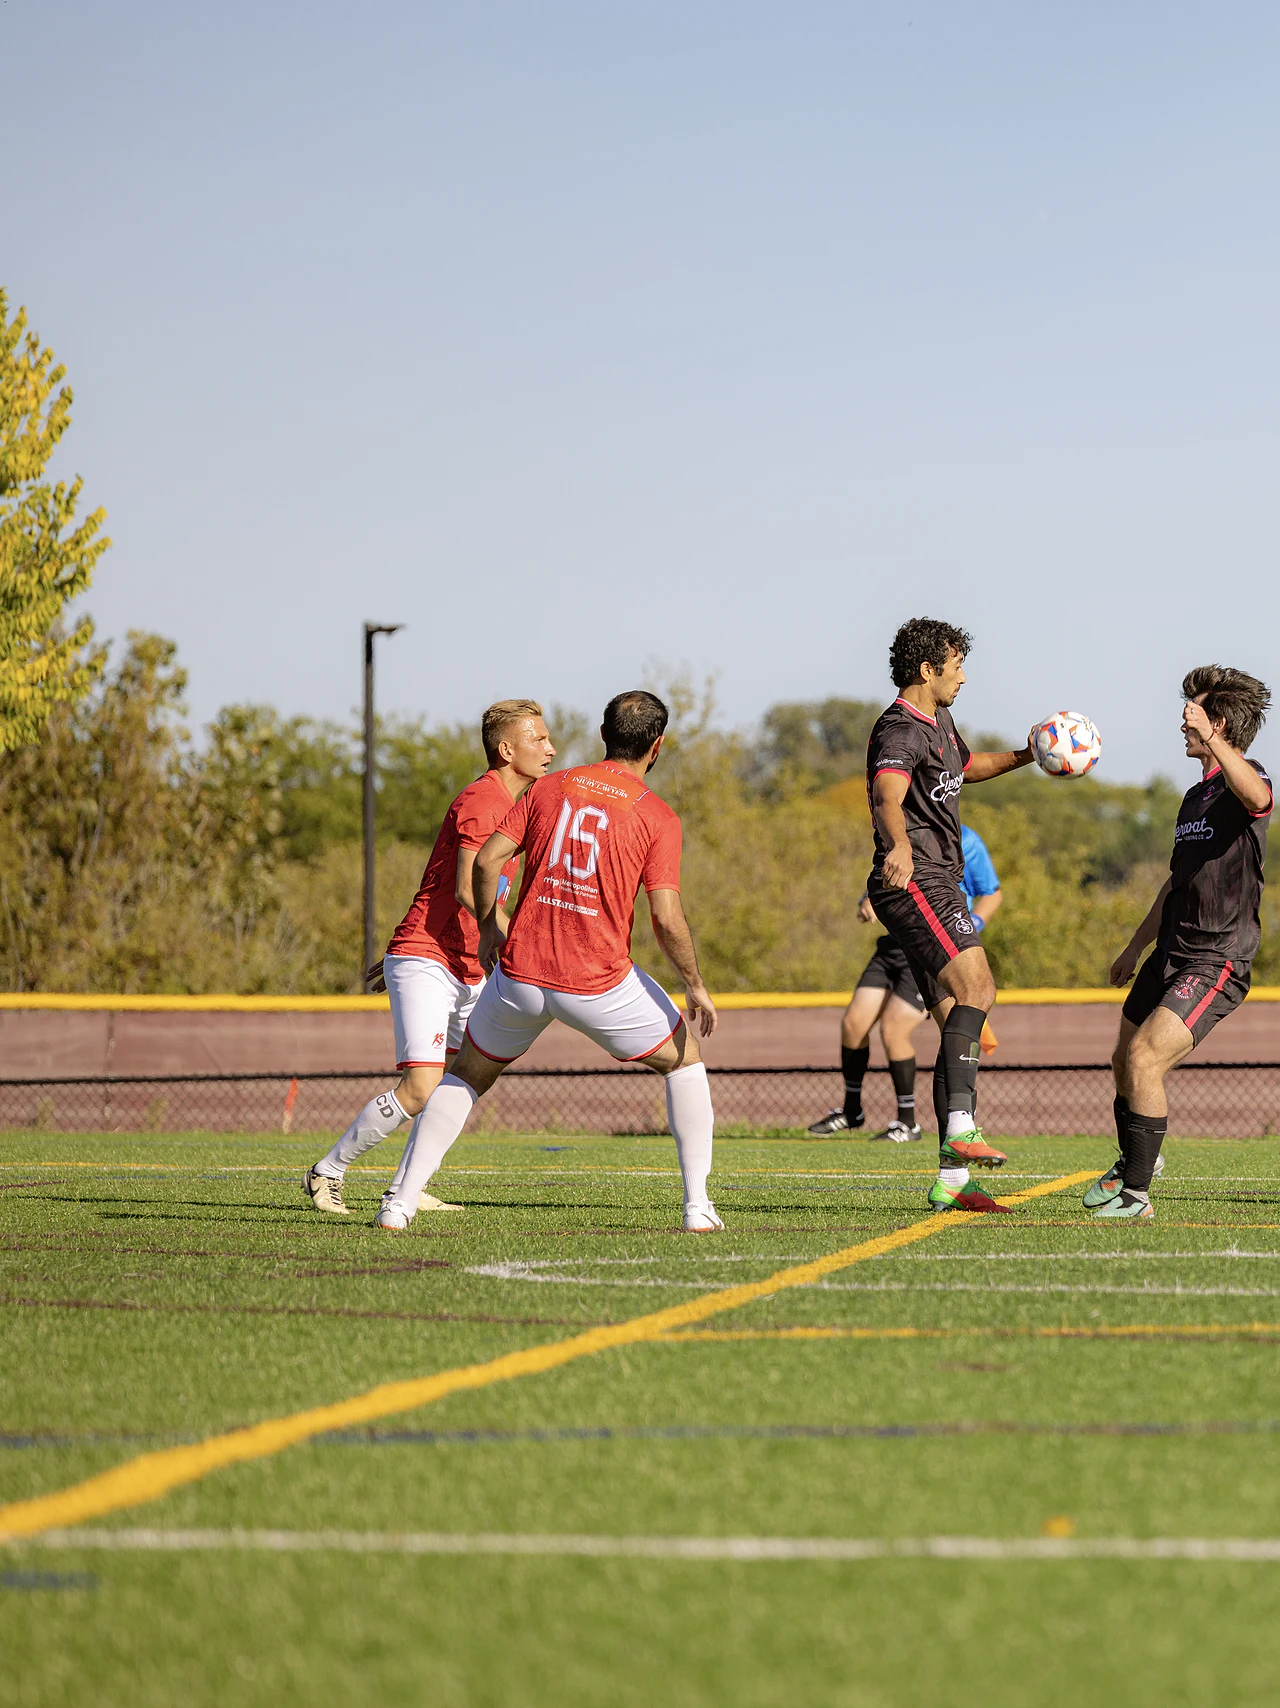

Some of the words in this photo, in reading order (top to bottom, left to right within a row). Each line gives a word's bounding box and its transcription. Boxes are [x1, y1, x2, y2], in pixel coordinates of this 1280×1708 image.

[596, 784, 629, 799] LAWYERS
[548, 797, 610, 880] 15
[536, 895, 575, 911] ALLSTATE
